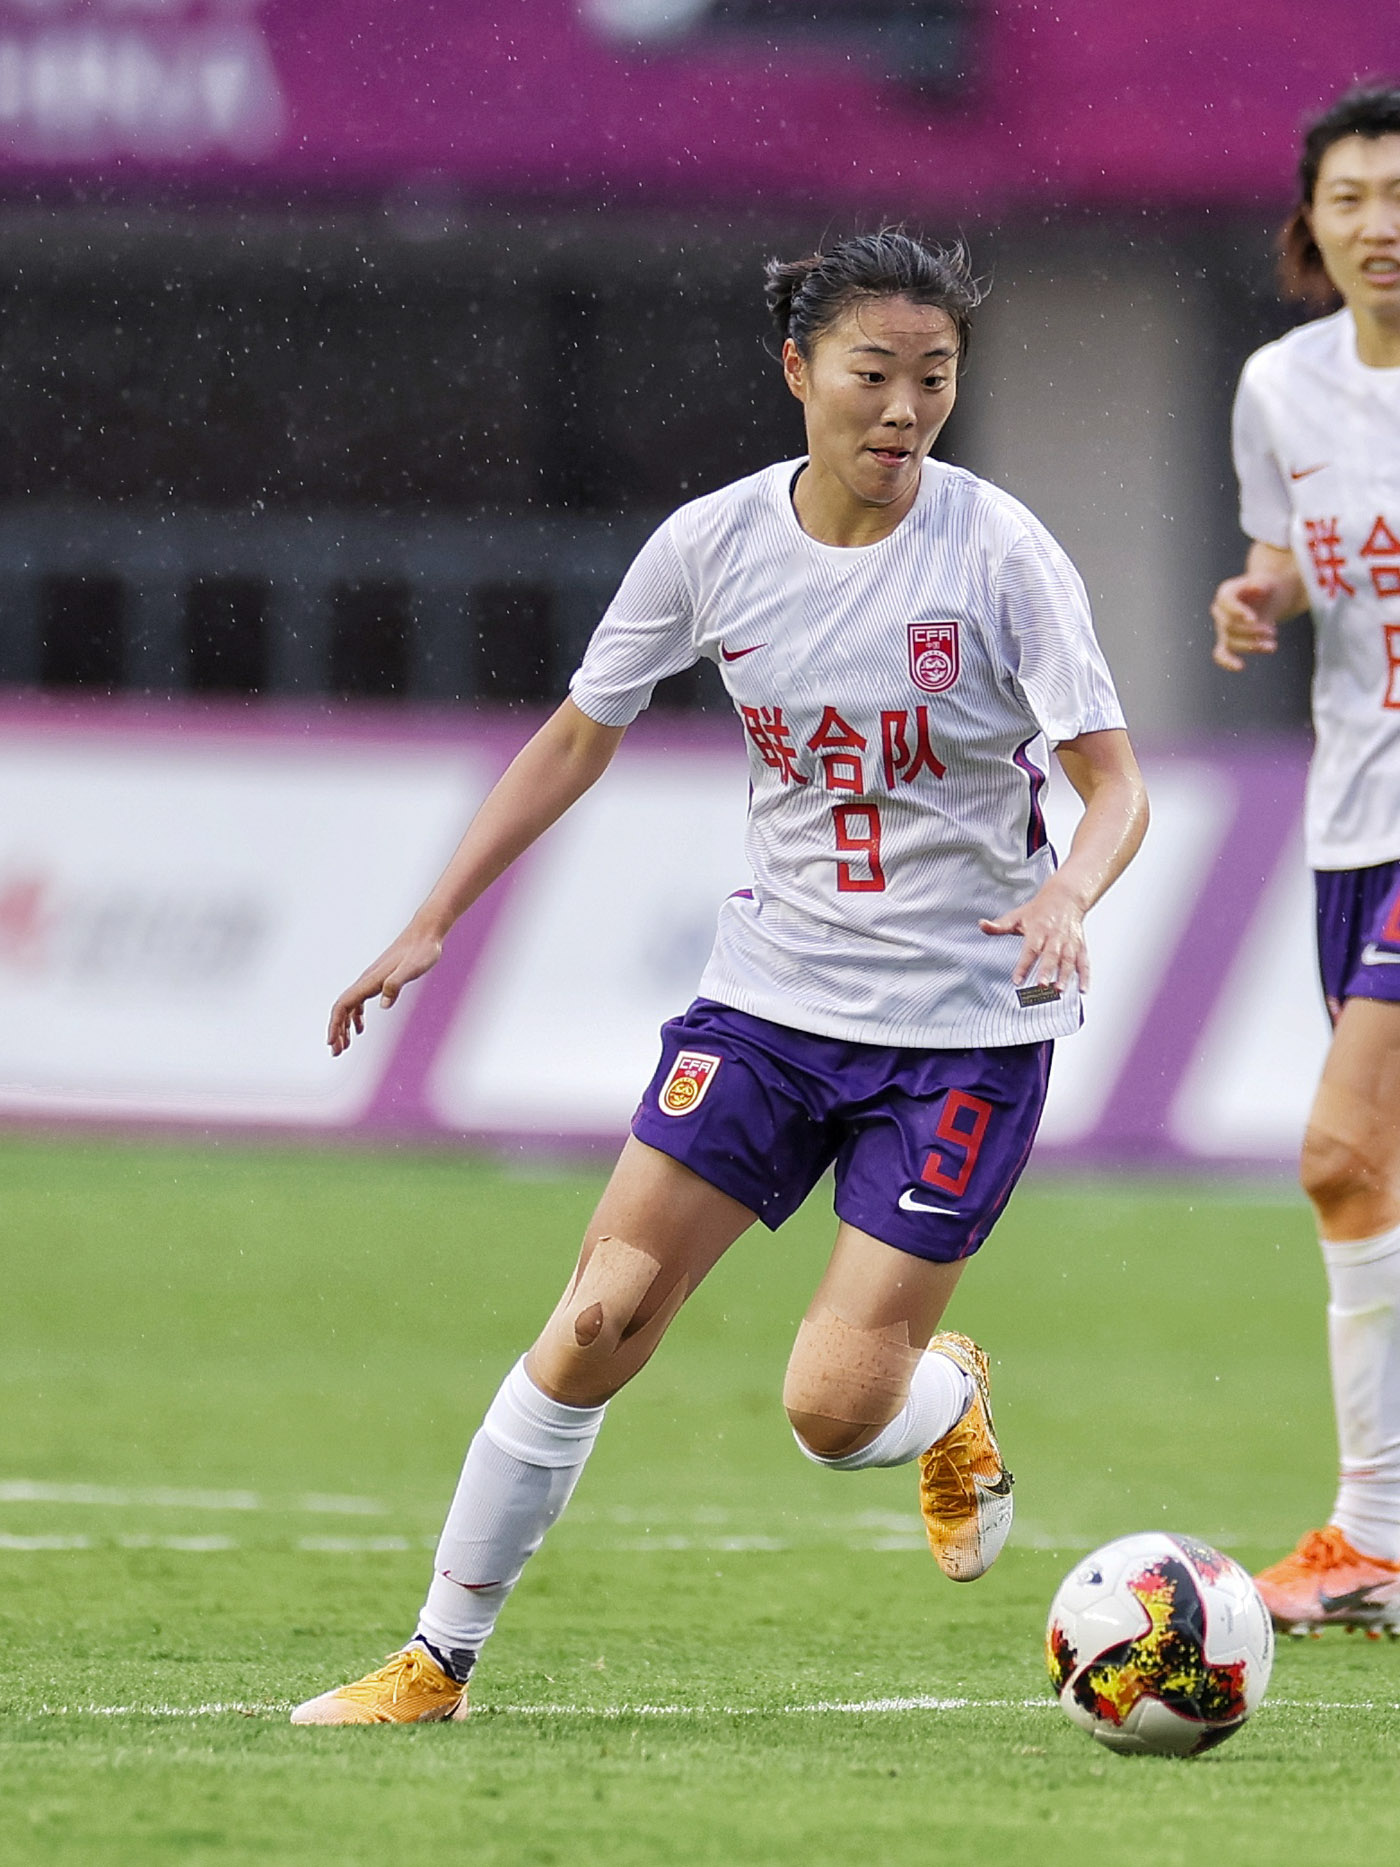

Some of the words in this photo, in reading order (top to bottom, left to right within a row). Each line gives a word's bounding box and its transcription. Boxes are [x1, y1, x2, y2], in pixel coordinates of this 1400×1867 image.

[914, 628, 952, 643] CFA
[739, 704, 947, 796] 联合队
[832, 803, 886, 893] 9
[679, 1058, 713, 1075] CFA
[920, 1088, 993, 1197] 9
